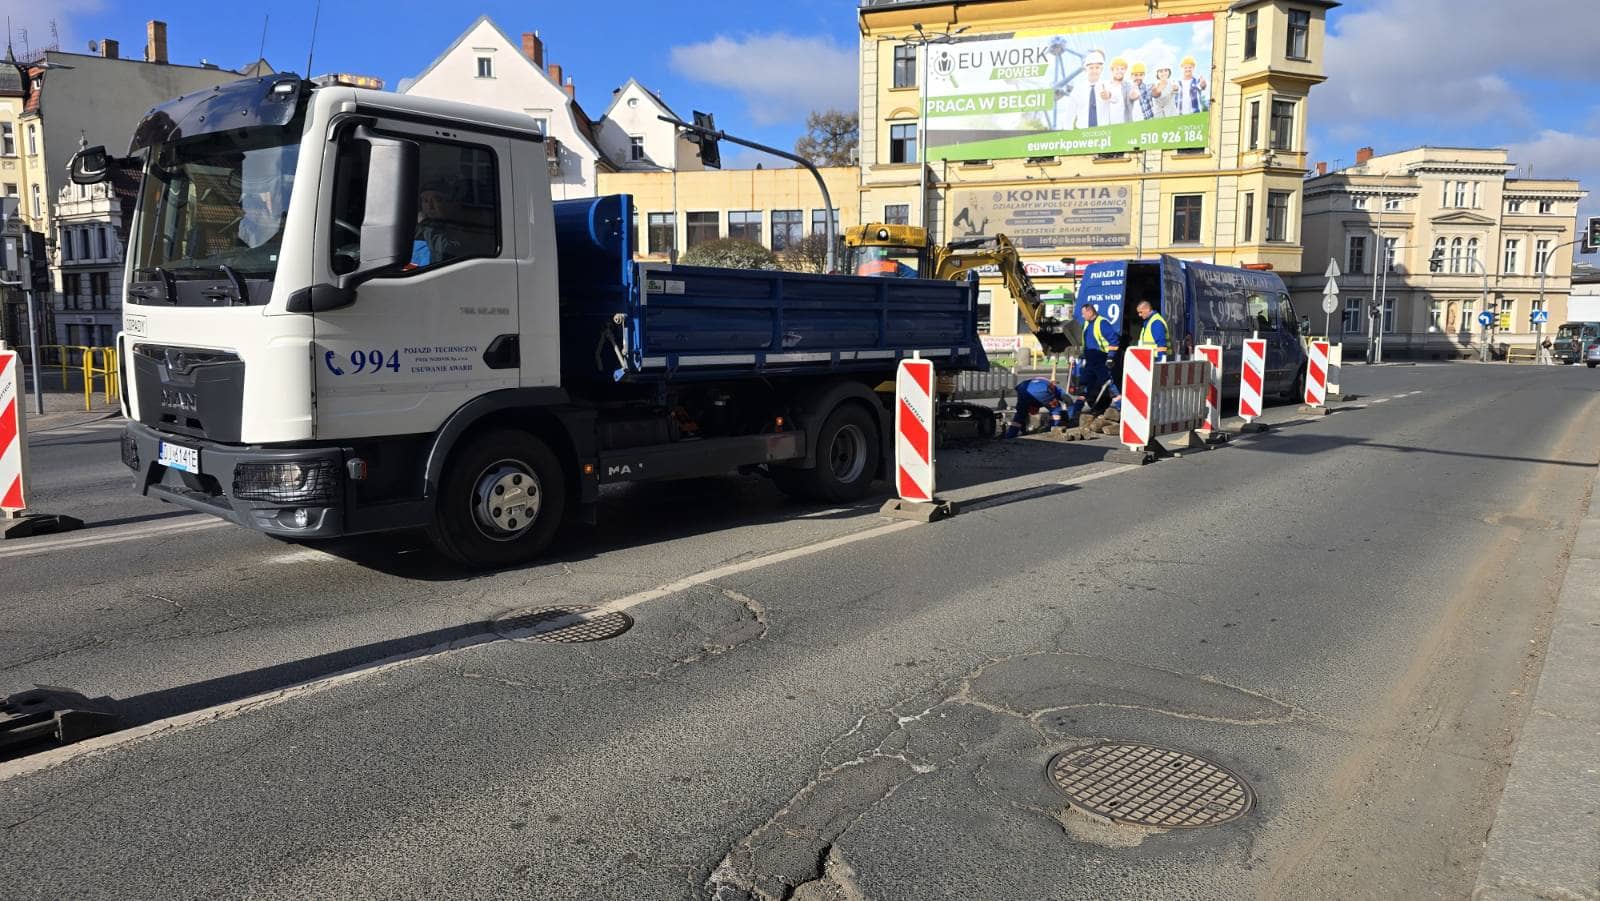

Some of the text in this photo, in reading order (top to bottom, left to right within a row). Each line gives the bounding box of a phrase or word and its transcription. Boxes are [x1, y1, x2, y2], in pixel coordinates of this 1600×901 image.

[958, 46, 1049, 70] EU WORK
[997, 66, 1040, 80] POWER
[927, 93, 1046, 114] PRACA W BELGII
[1027, 136, 1112, 152] euworkpower.pl
[1141, 132, 1158, 145] 510
[1162, 131, 1181, 143] 926
[1184, 129, 1203, 142] 184
[1006, 187, 1112, 202] KONEKTIA
[1090, 270, 1115, 279] POJAZD
[435, 345, 478, 353] TECHNICZNY
[350, 349, 401, 375] 994
[411, 365, 448, 373] USUWANIE
